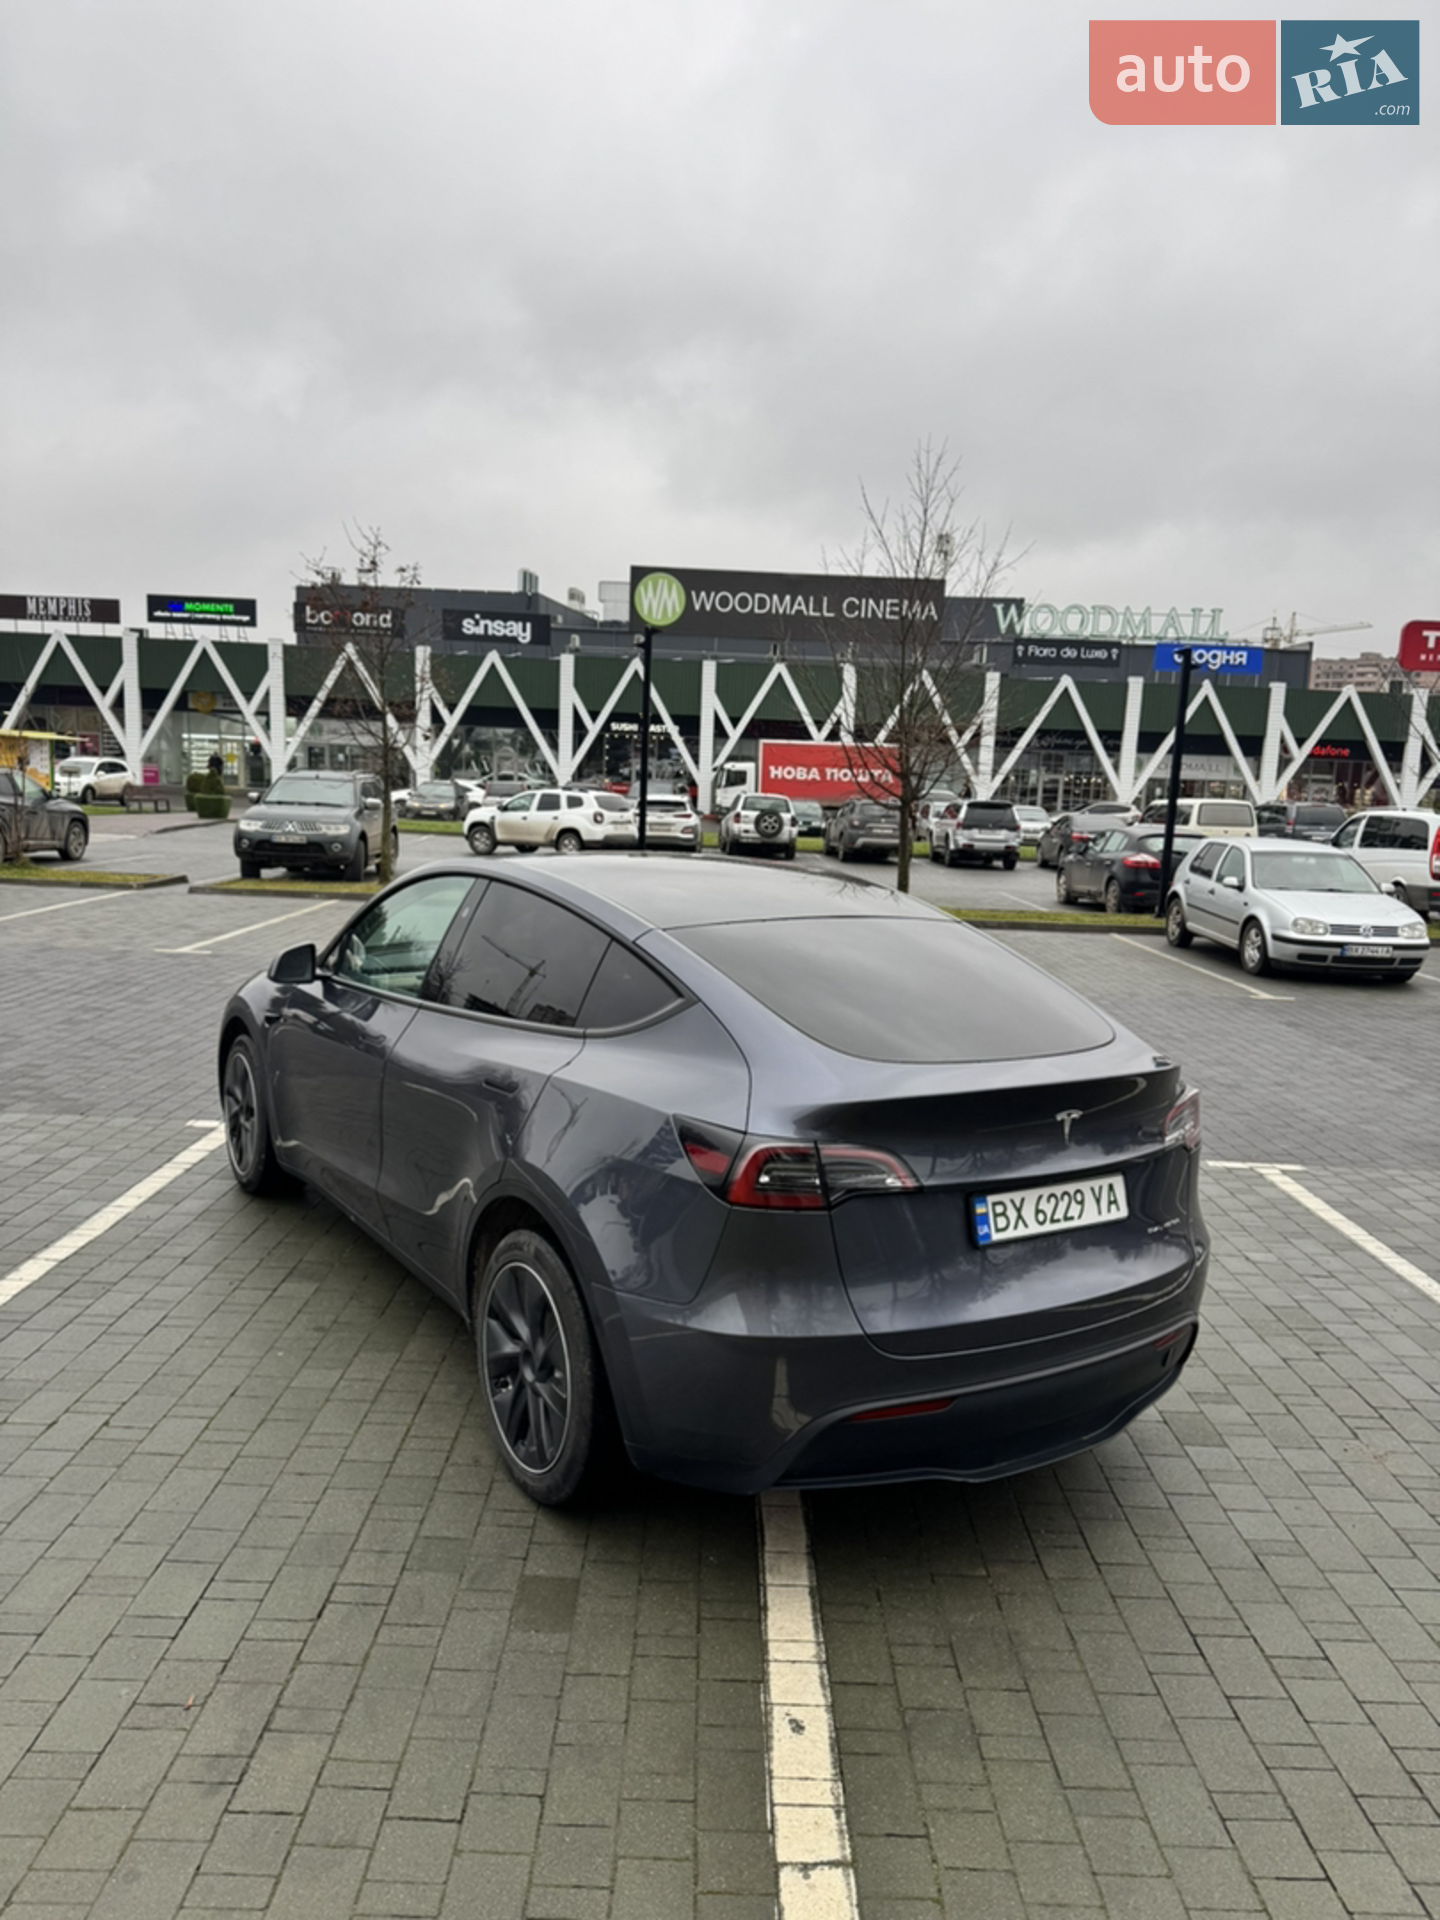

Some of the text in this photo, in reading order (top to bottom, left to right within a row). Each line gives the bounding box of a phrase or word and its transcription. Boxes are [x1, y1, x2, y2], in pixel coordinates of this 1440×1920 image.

[26, 596, 91, 617] MEMPHIS
[690, 590, 939, 622] WOODMALL CINEMA
[461, 613, 532, 644] sinsay
[993, 603, 1228, 642] WOODMALL
[1027, 645, 1108, 660] Flora de Luxe
[769, 765, 893, 784] НОВА ПОШТА
[991, 1182, 1121, 1233] BX 6229 YA
